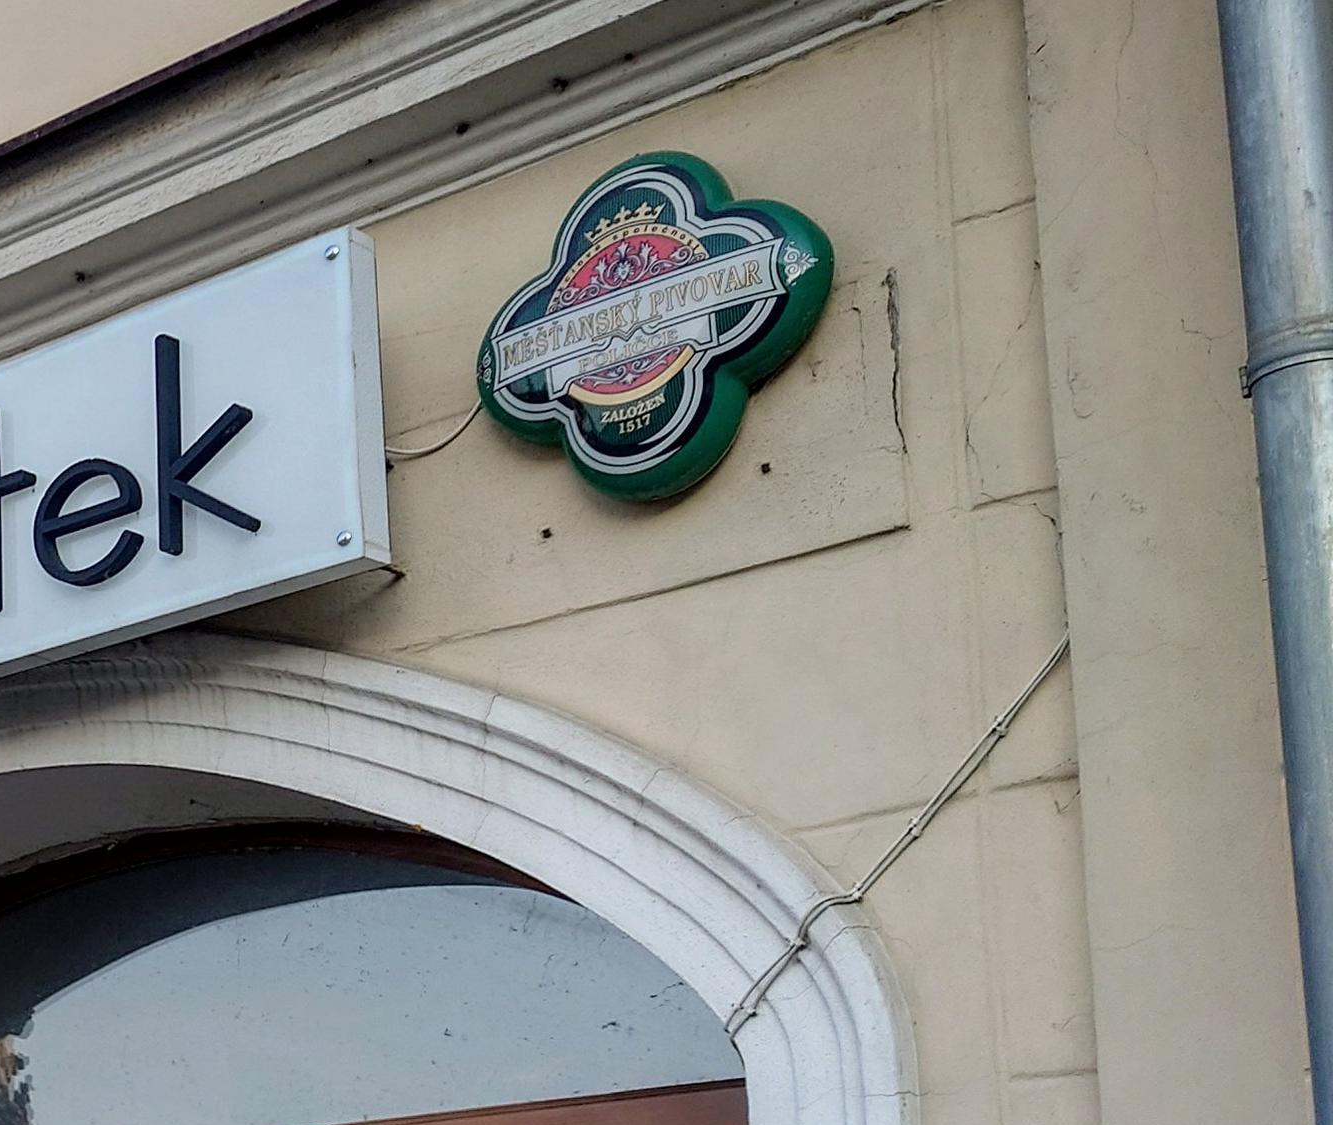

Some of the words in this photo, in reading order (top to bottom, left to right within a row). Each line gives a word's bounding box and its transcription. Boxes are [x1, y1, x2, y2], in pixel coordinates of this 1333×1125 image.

[503, 291, 643, 371] MĚŠŤANSKÝ
[650, 260, 763, 317] PIVOVAR
[578, 328, 678, 373] POLIČCE
[601, 393, 665, 423] ZALOŽEN
[619, 414, 650, 434] 1517
